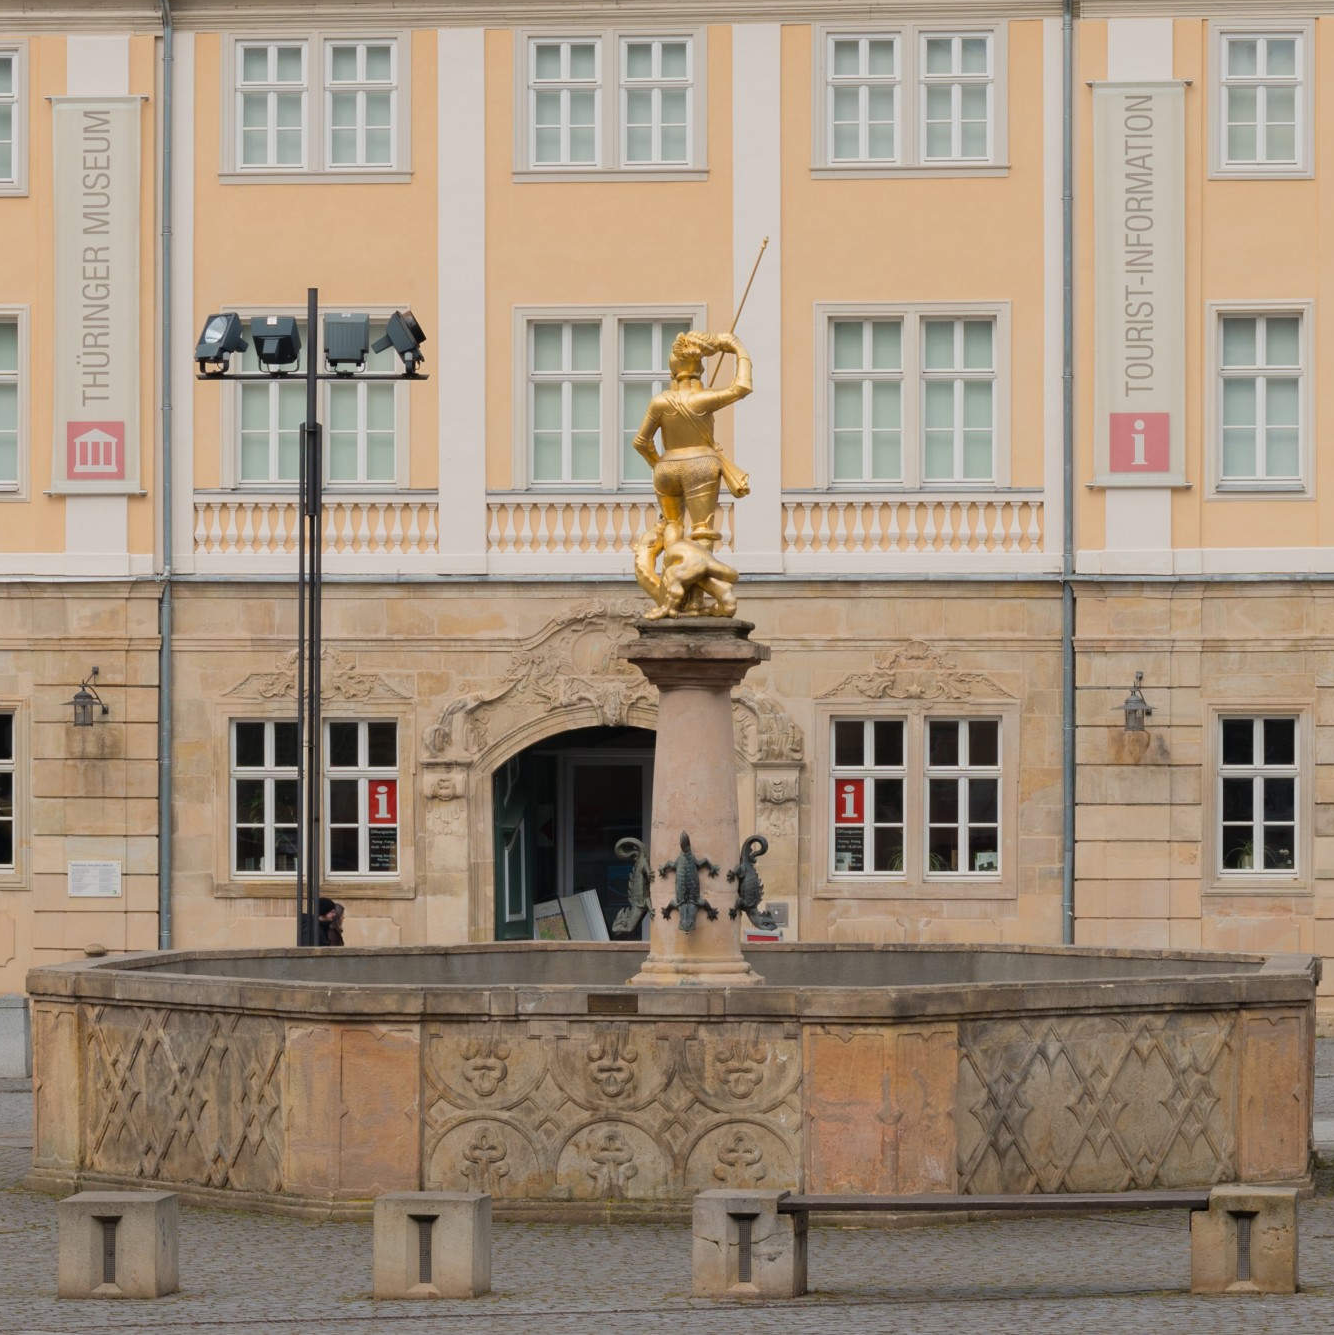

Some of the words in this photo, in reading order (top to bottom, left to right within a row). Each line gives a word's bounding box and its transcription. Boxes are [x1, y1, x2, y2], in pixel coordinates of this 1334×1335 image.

[82, 109, 111, 236] MUSEUM
[1124, 94, 1154, 398] TOURIST-INFORMATION
[75, 244, 111, 408] THÜRINGER
[375, 785, 391, 818] i
[841, 785, 858, 818] i
